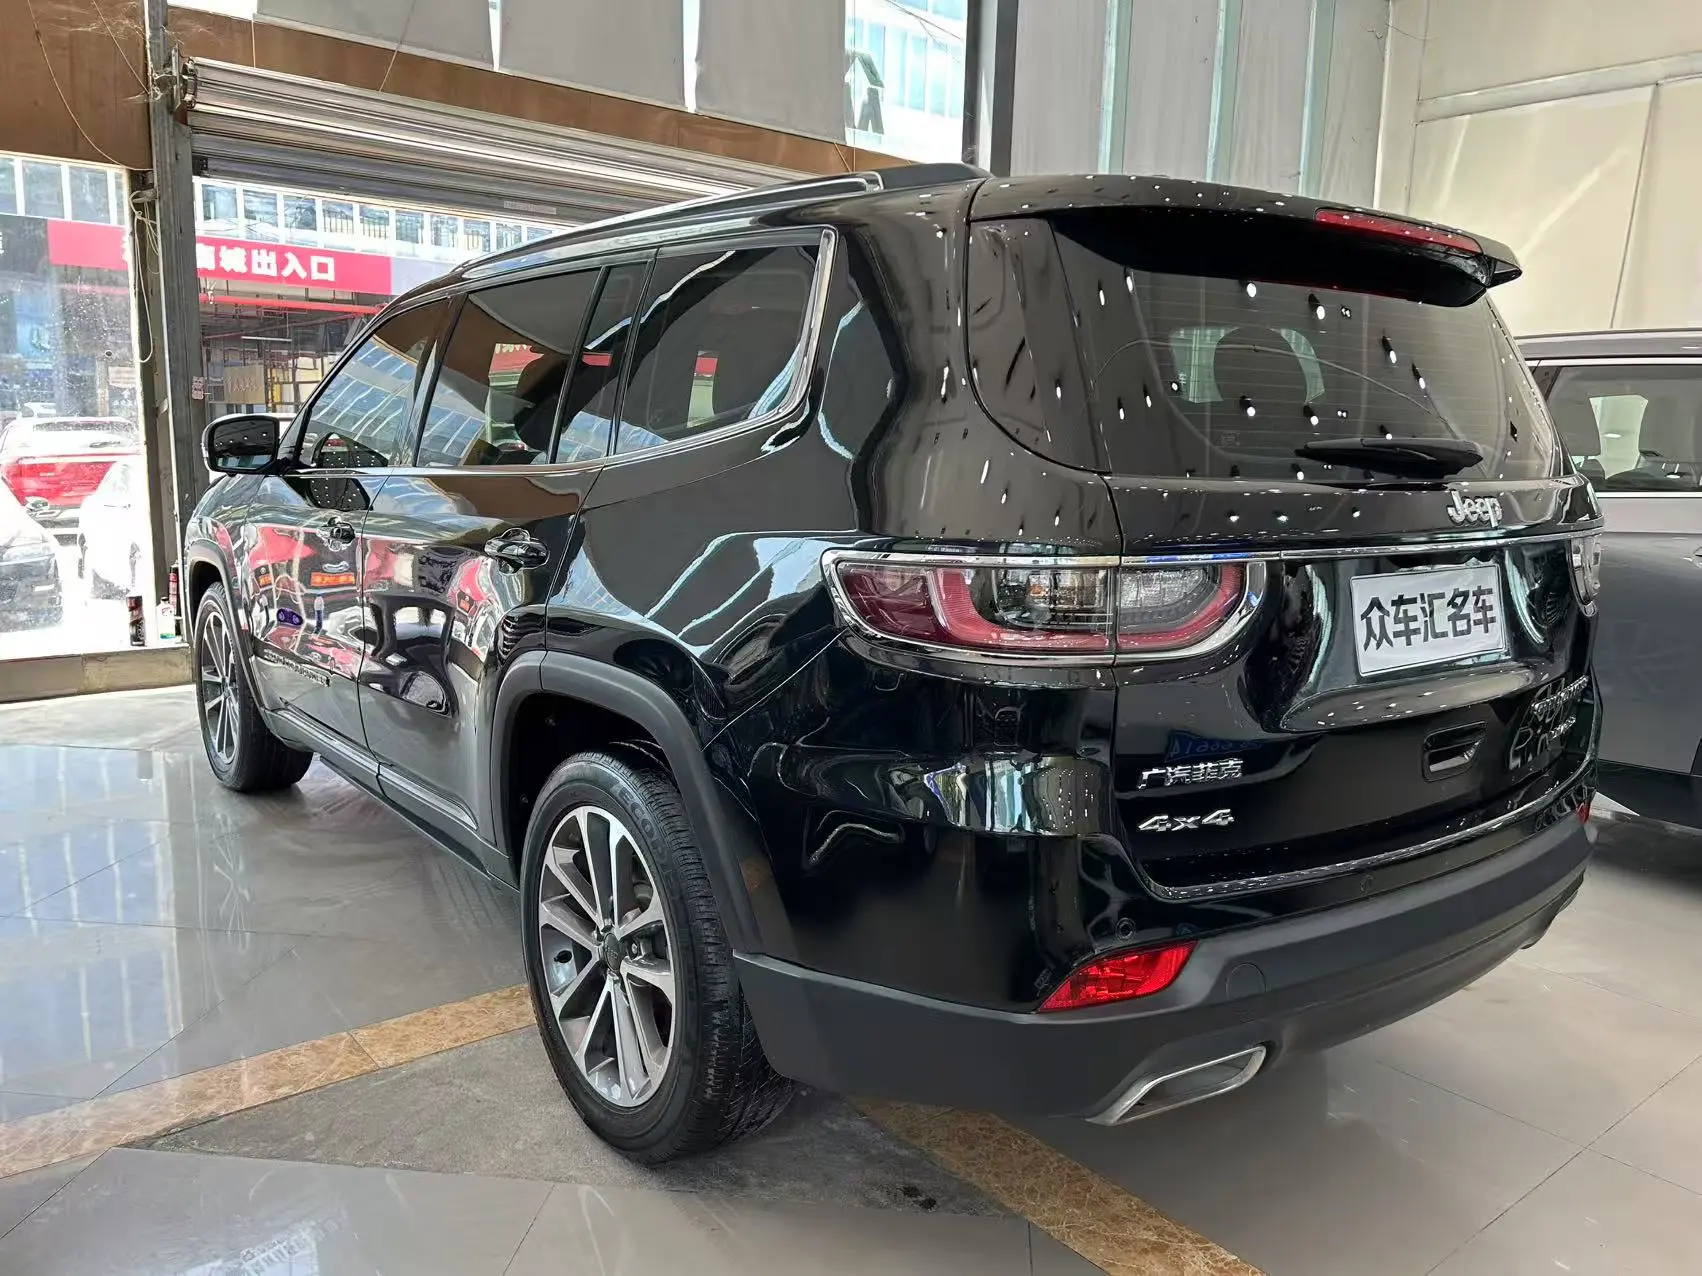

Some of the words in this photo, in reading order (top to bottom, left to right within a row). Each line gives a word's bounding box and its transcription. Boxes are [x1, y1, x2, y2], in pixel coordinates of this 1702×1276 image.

[1446, 490, 1503, 528] Jeep
[1360, 585, 1497, 652] 众车汇名车
[1137, 757, 1244, 790] 广汽菲克
[1138, 808, 1235, 832] 4x4
